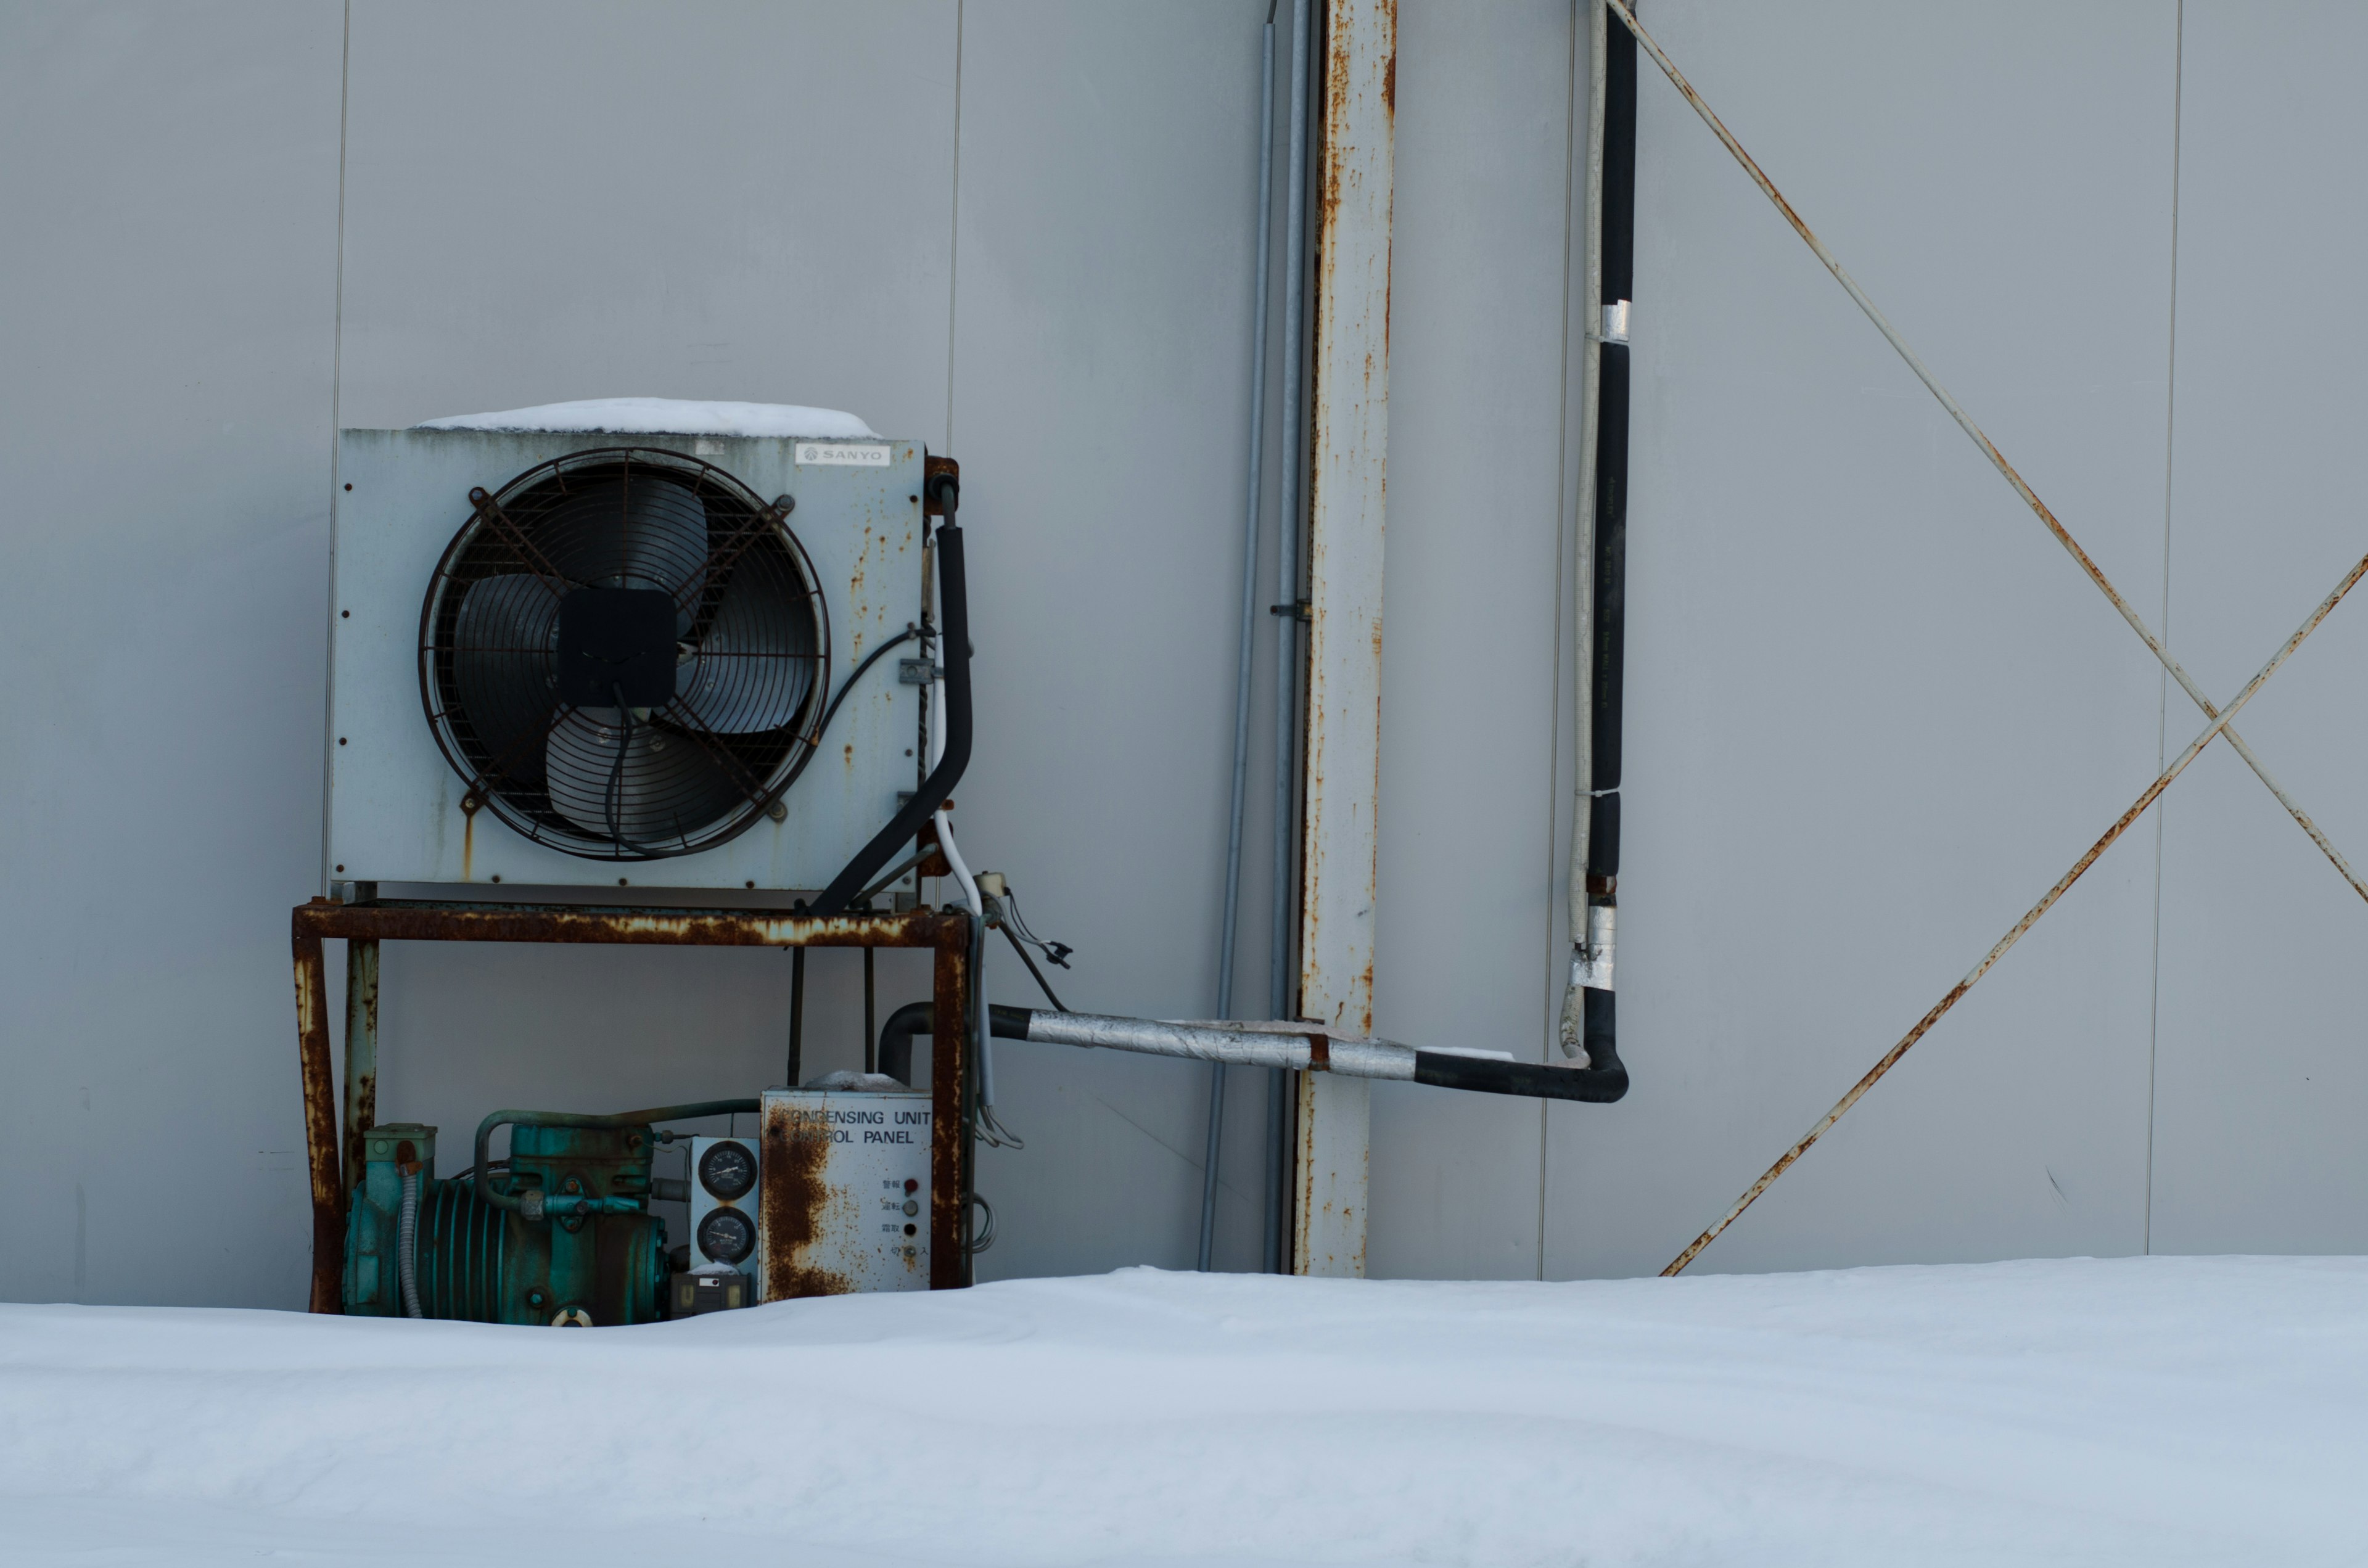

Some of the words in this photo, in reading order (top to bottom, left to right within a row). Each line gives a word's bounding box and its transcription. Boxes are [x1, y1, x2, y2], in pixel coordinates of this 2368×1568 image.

[823, 450, 882, 460] SANYO
[779, 1109, 884, 1125] CONDENSING
[895, 1111, 931, 1125] UNIT
[779, 1130, 854, 1143] CONTROL
[864, 1131, 914, 1144] PANEL
[882, 1180, 900, 1189] 警報
[881, 1202, 900, 1210] 運転
[882, 1224, 900, 1233] 霜取
[890, 1247, 900, 1256] 切
[920, 1247, 929, 1255] 入
